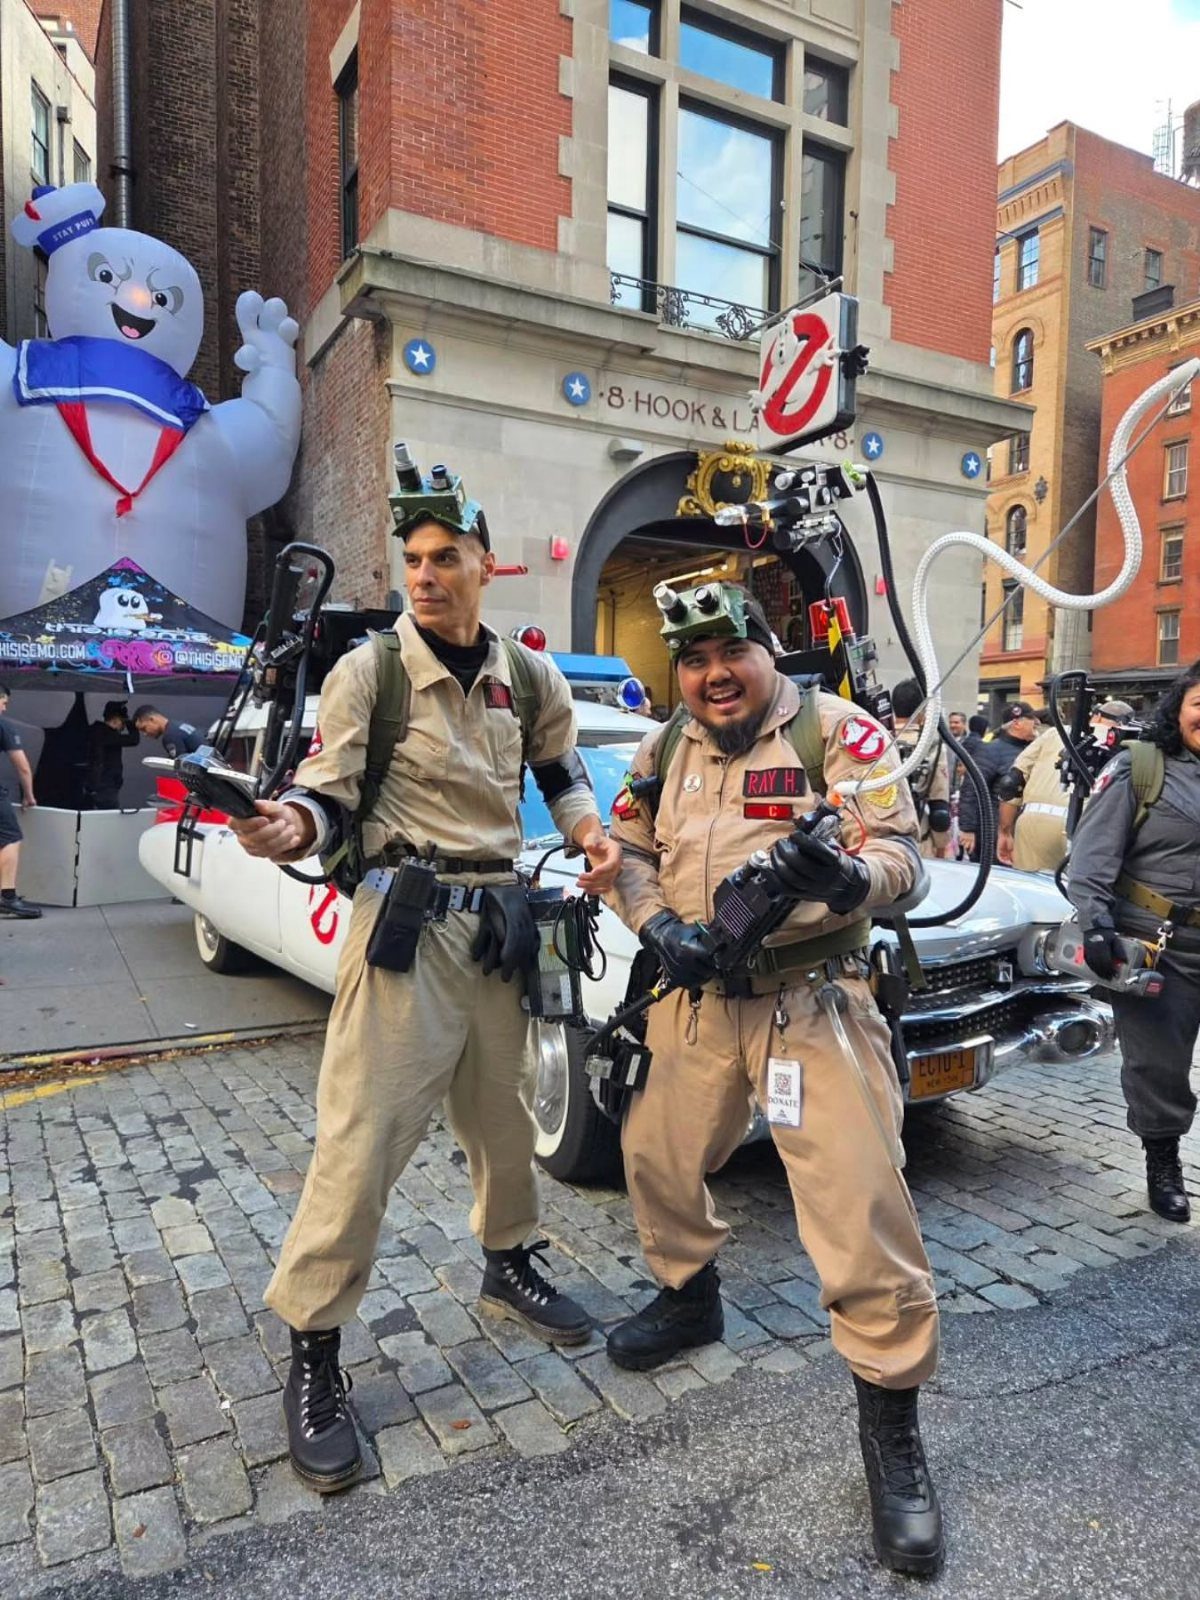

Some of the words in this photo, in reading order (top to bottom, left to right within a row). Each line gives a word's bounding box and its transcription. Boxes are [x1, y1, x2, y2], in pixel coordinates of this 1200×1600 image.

[52, 226, 73, 241] STAY
[634, 390, 707, 425] HOOK
[711, 406, 727, 429] &
[0, 641, 85, 659] HISISEMO.COM
[748, 770, 777, 794] RAY
[767, 1096, 799, 1109] DONATE
